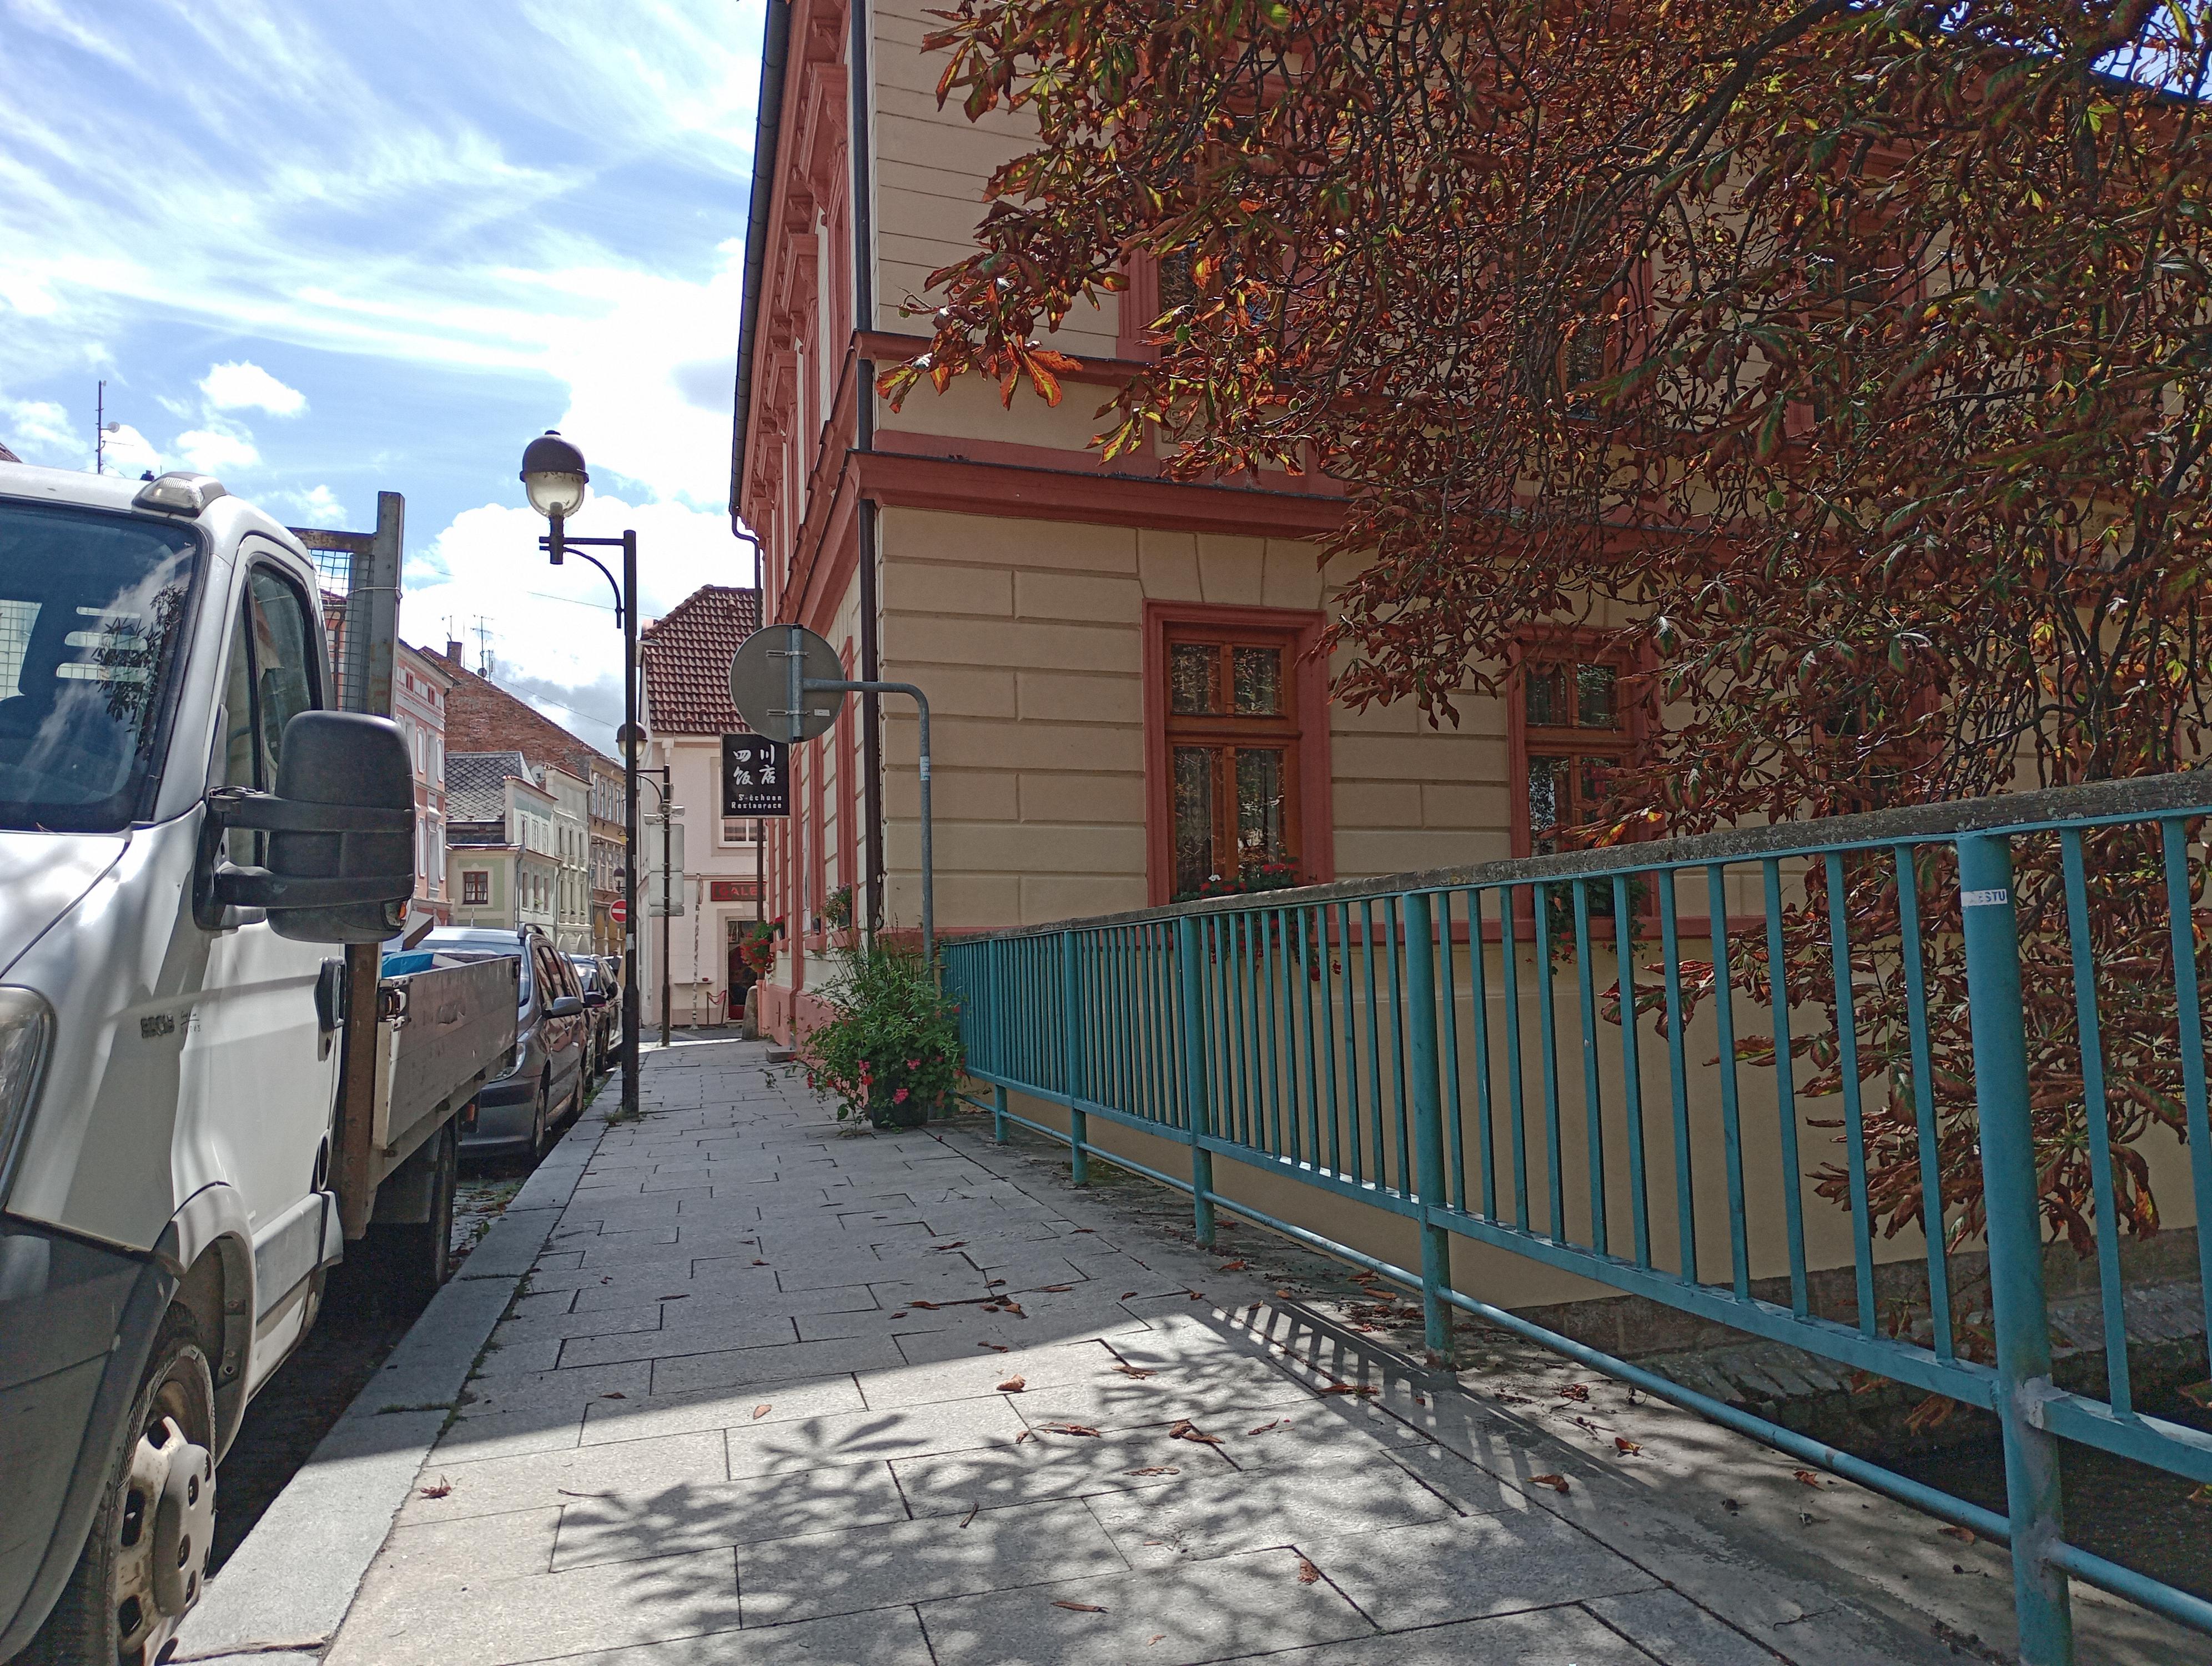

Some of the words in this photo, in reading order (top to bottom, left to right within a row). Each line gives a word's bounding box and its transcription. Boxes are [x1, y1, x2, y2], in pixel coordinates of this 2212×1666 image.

[732, 744, 775, 765] 四川
[733, 765, 776, 785] 饭店
[731, 801, 782, 810] Restaurace
